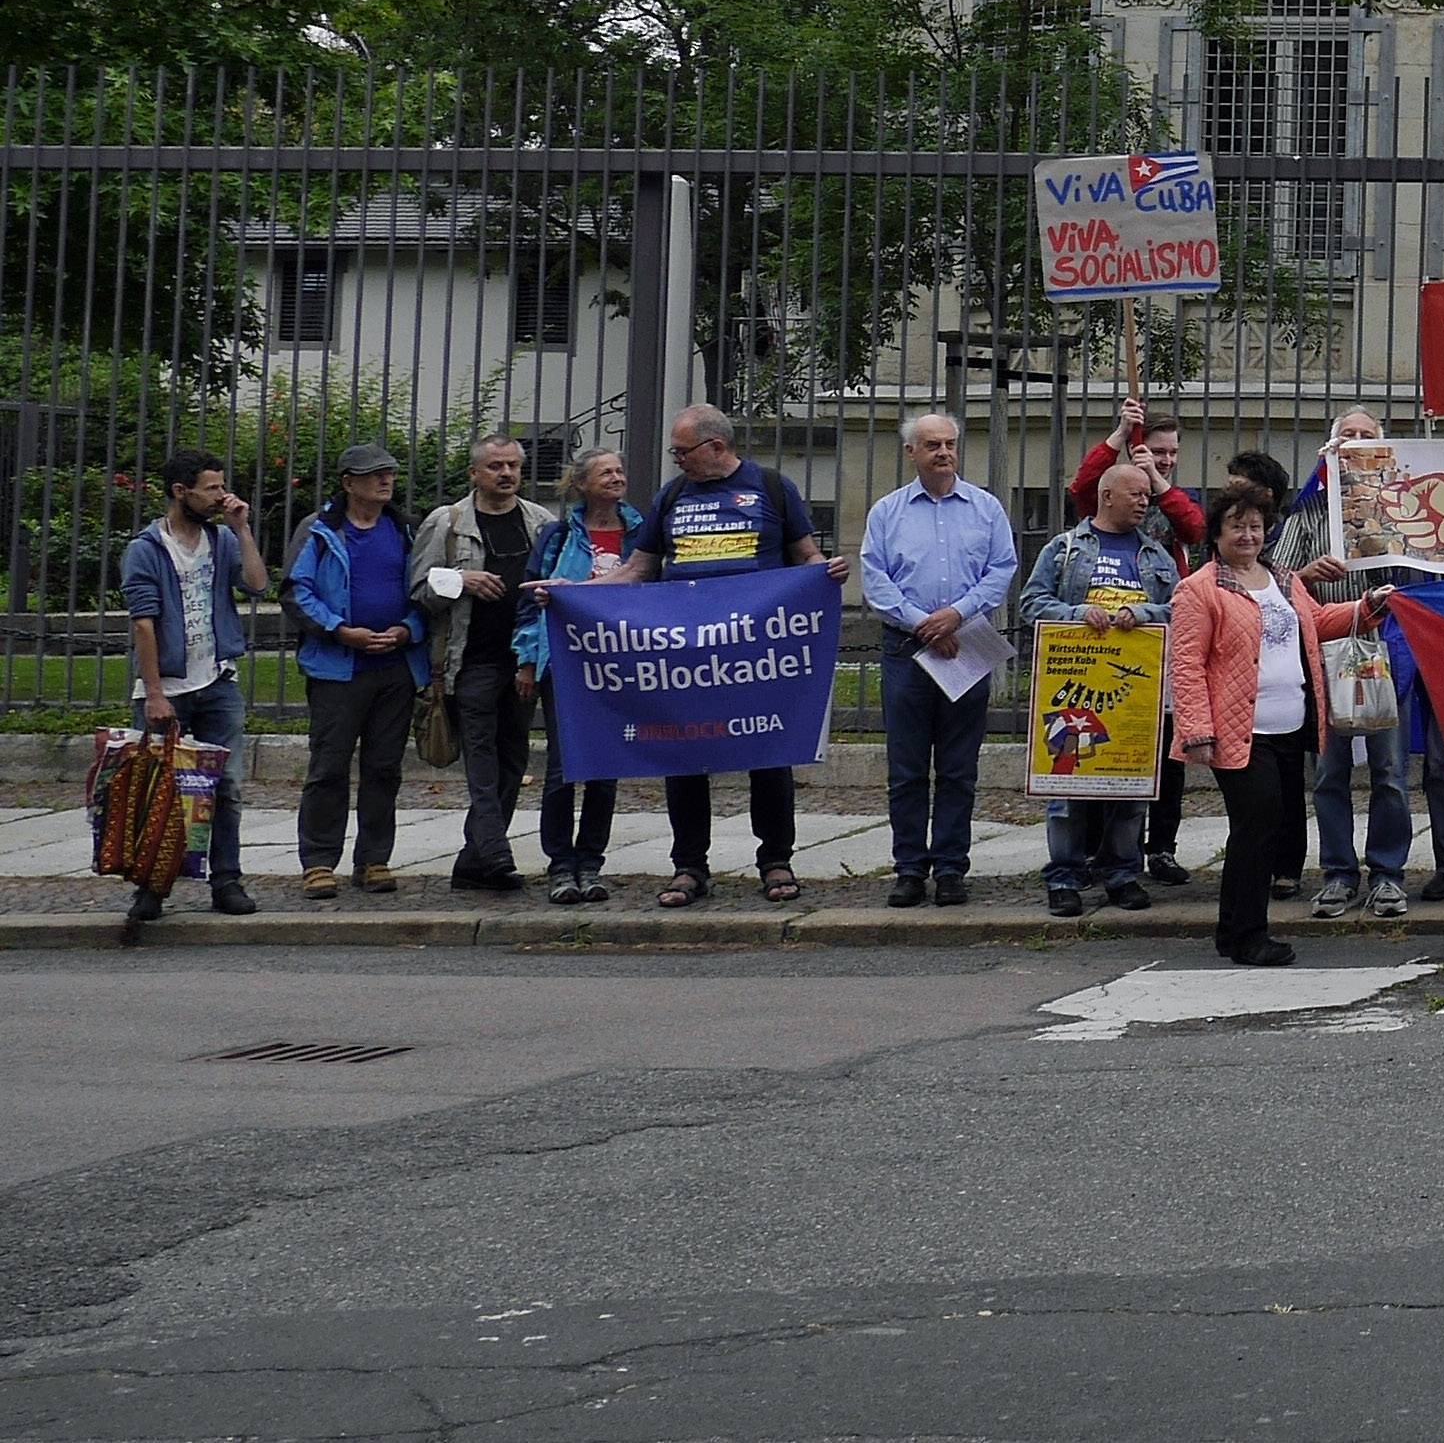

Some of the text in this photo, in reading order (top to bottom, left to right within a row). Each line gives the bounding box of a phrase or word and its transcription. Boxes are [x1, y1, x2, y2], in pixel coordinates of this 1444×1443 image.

[675, 501, 720, 514] SCHLUSS
[674, 514, 717, 524] MIT DER
[1097, 556, 1121, 566] LUSS
[566, 606, 824, 653] Schluss mit der
[1048, 644, 1121, 656] Wirtschaftskrieg
[1046, 656, 1096, 665] gegen Kuba
[583, 645, 812, 692] US-Blockade!
[1046, 666, 1088, 676] beenden!
